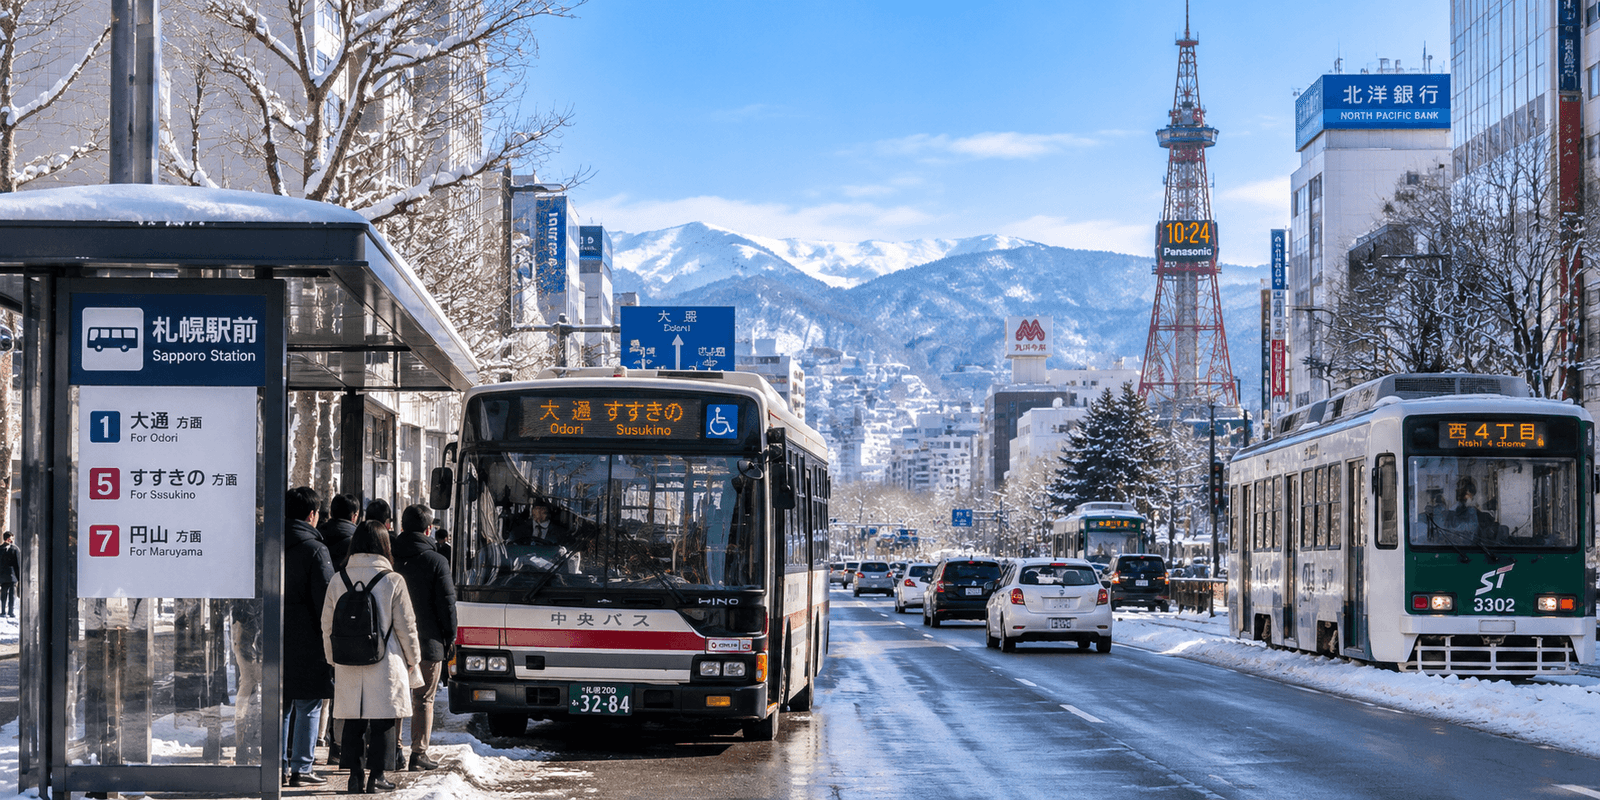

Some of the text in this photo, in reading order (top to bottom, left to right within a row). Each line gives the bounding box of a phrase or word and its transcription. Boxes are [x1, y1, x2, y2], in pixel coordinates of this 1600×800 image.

[1343, 85, 1438, 104] 北洋銀行
[1340, 111, 1439, 120] NORTH PACIFIC BANK
[1166, 222, 1210, 244] 10:24
[1163, 247, 1212, 256] Panasonic
[152, 316, 258, 344] 札幌駅前
[152, 350, 256, 364] Sapporo Station
[130, 411, 169, 429] 大通
[604, 401, 683, 422] すすきの
[100, 415, 109, 438] 1
[550, 423, 672, 436] Odori Susukino
[1448, 423, 1535, 440] 西4丁目
[130, 433, 178, 442] For Odori
[1496, 439, 1526, 447] chome
[97, 472, 113, 496] 5
[130, 469, 205, 487] すすきの
[130, 490, 146, 499] For
[96, 530, 113, 553] 7
[130, 525, 168, 544] 円山
[129, 547, 203, 558] For Maruyama
[1473, 597, 1515, 612] 3302
[550, 612, 650, 627] 中央バス
[580, 694, 629, 713] 32-84
